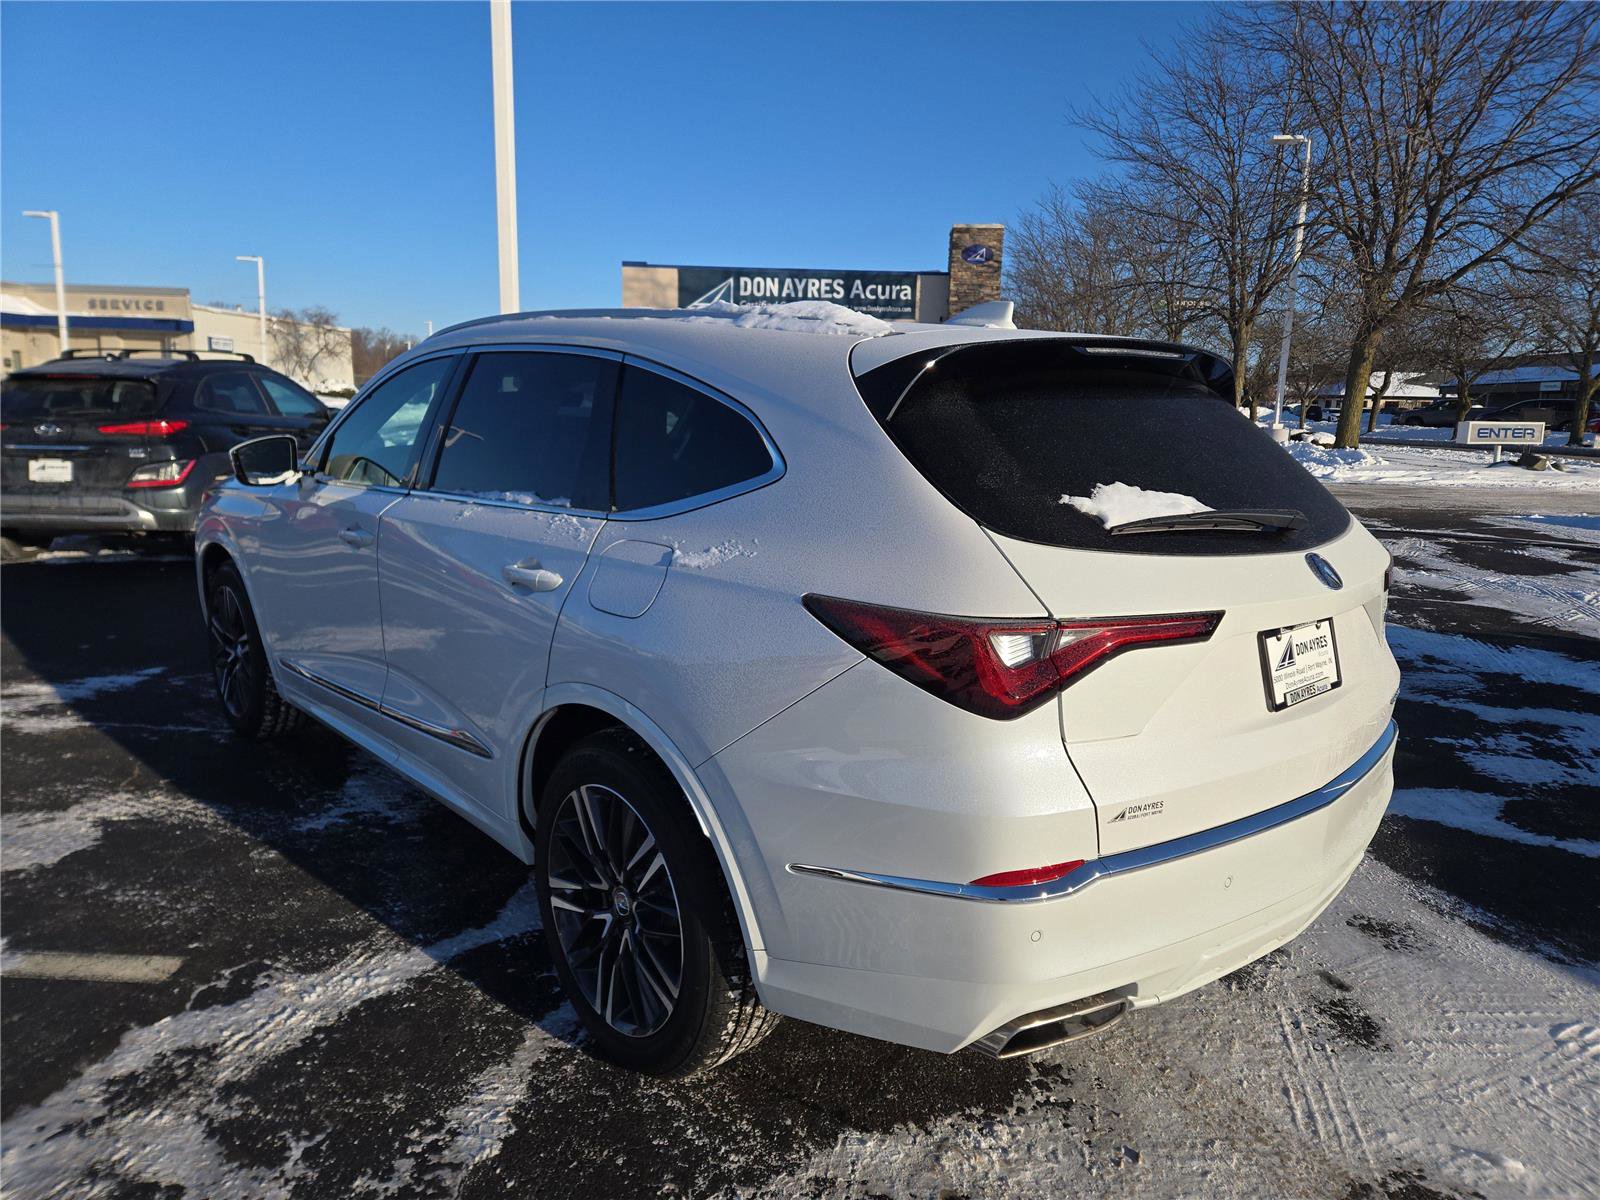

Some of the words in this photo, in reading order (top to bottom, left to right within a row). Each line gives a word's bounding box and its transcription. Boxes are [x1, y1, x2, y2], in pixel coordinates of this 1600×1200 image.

[739, 276, 779, 297] DON
[781, 277, 845, 299] AYRES
[849, 279, 912, 300] Acura
[88, 298, 164, 311] SERVICE
[1477, 427, 1535, 438] ENTER
[1295, 641, 1310, 656] DON
[1309, 635, 1328, 653] AYRES
[1290, 691, 1302, 703] DON
[1301, 684, 1316, 698] AYRES
[1127, 804, 1142, 814] DON
[1142, 801, 1164, 812] AYRES
